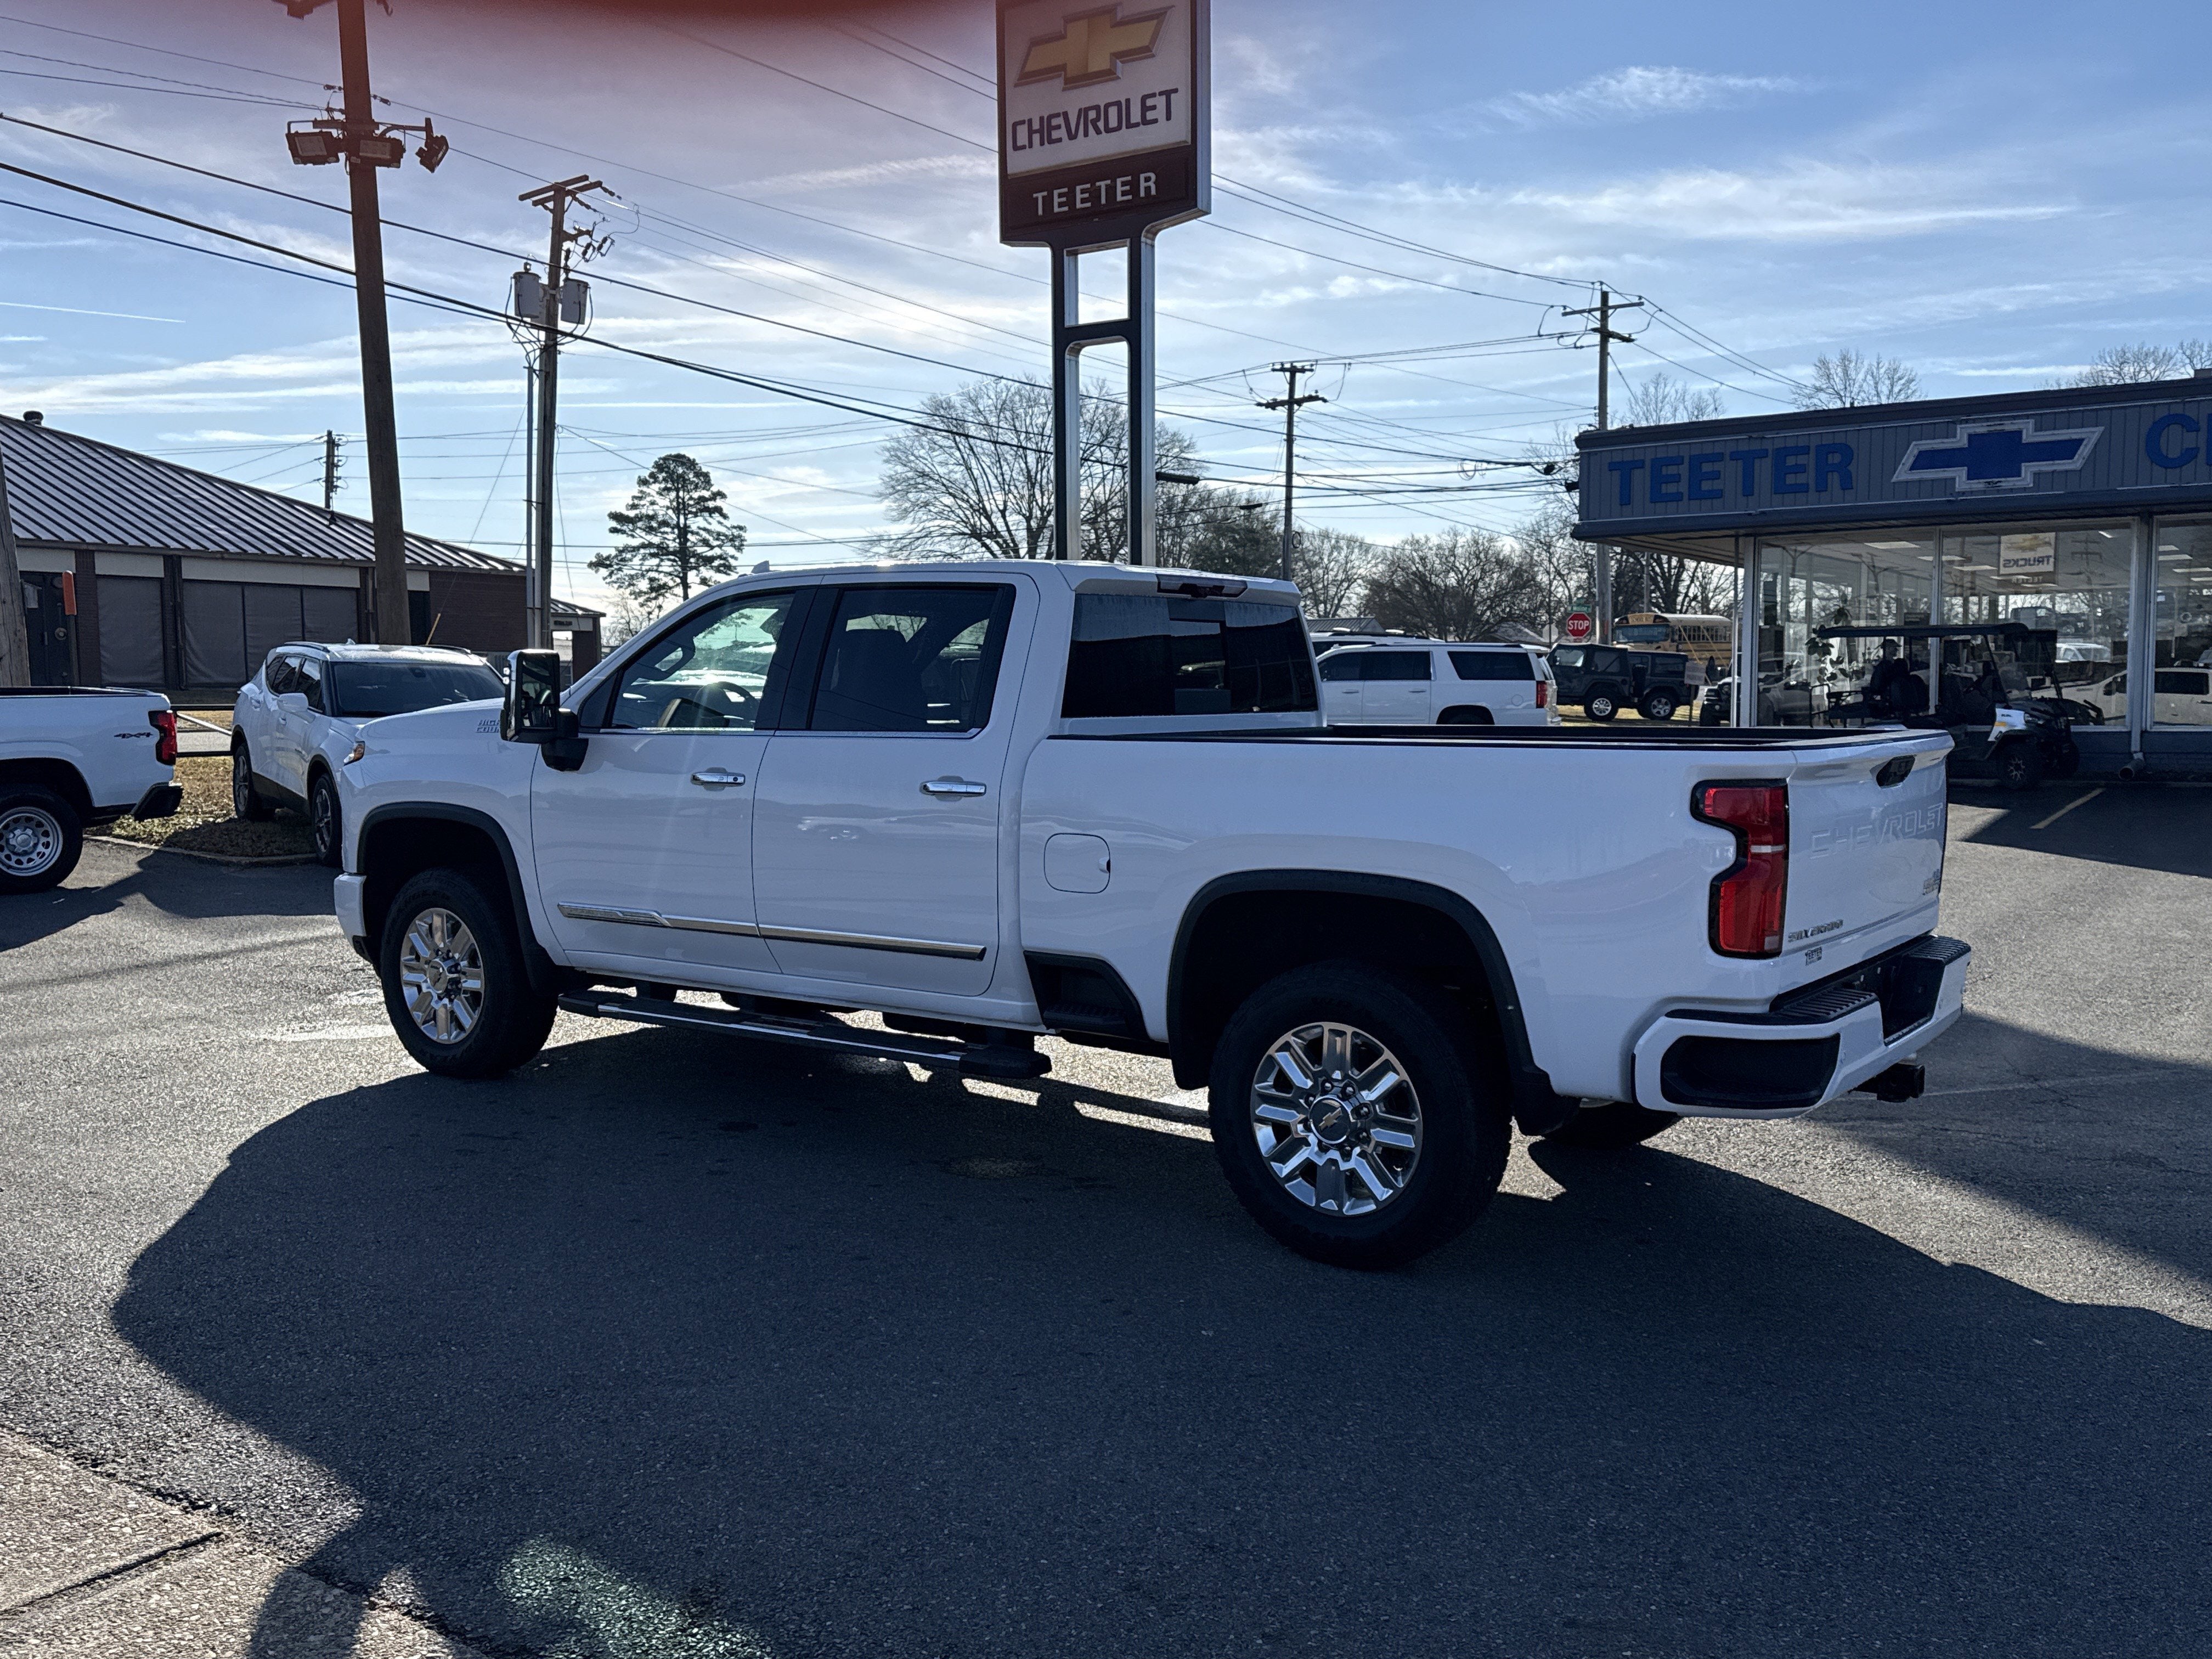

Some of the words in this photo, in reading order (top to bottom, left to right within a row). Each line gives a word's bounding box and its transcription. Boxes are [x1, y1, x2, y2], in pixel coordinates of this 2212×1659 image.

[1012, 88, 1178, 151] CHEVROLET
[1033, 172, 1157, 216] TEETER
[1608, 442, 1854, 506] TEETER
[2146, 413, 2212, 469] C
[1568, 620, 1590, 630] STOP
[1810, 802, 1943, 860] CHEVROLET
